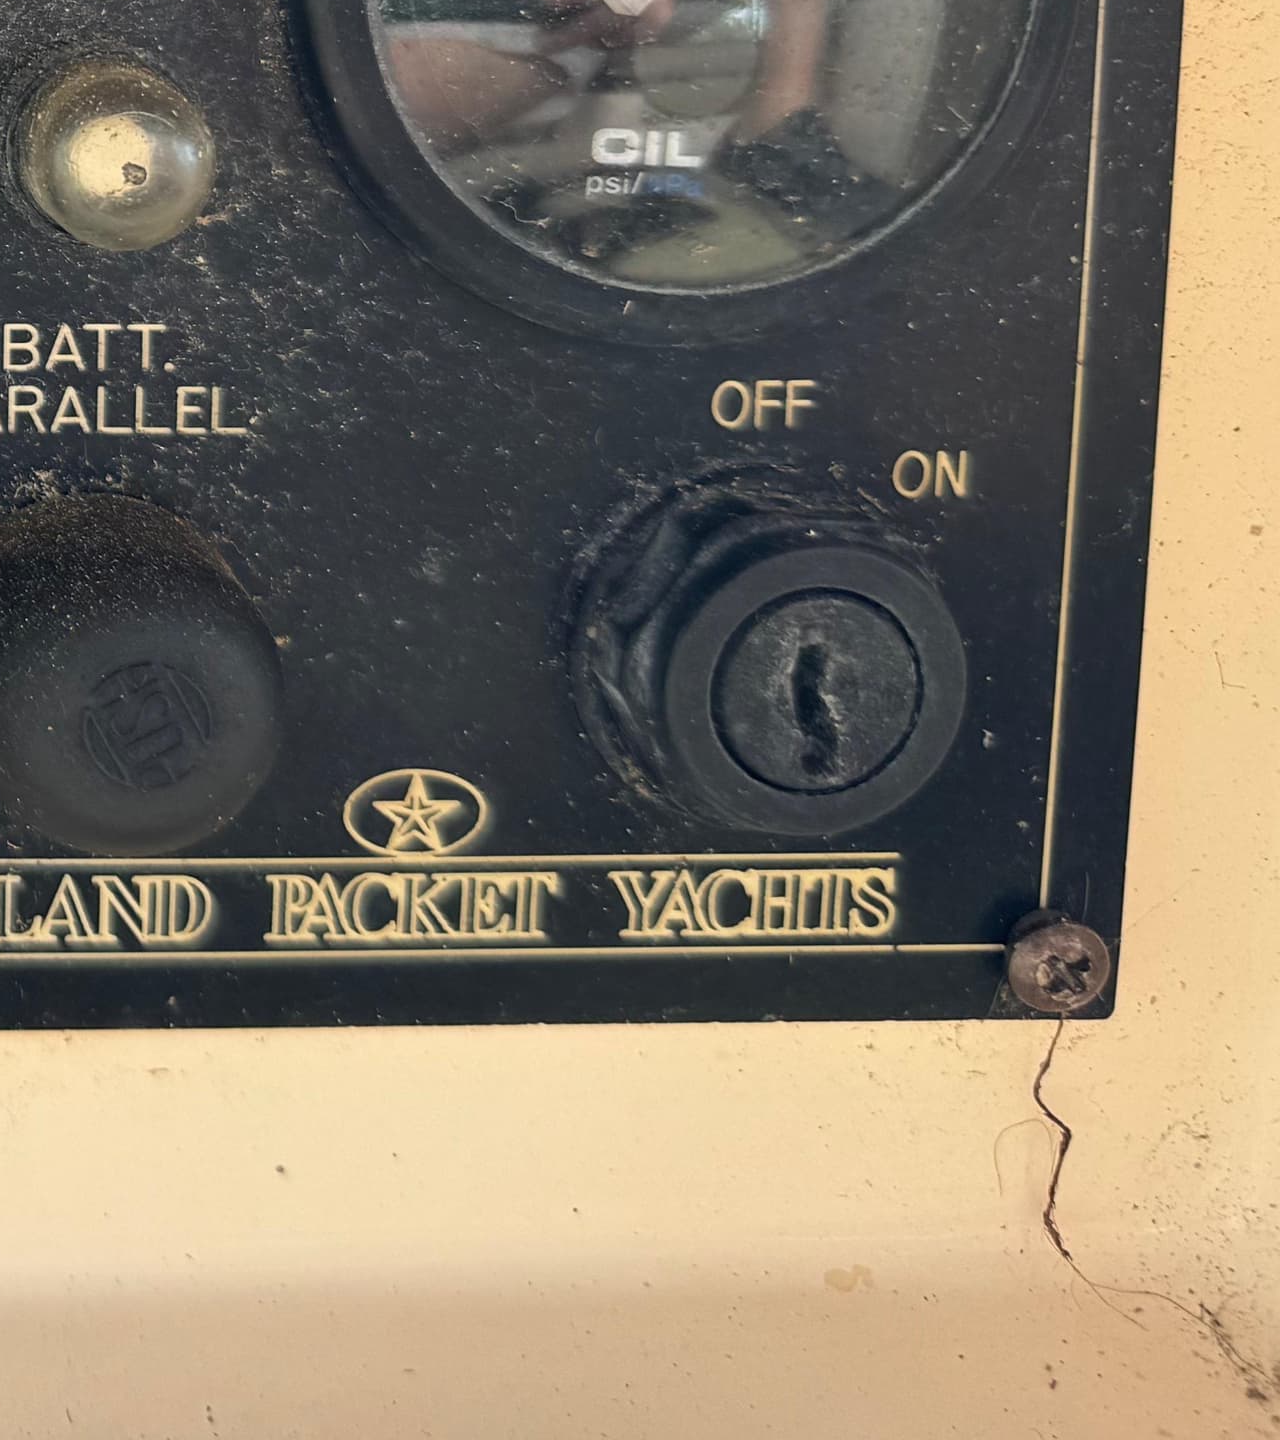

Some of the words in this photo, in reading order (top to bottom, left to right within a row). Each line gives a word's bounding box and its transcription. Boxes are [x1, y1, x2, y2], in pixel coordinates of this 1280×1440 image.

[591, 127, 705, 168] OIL
[2, 322, 176, 373] BATT.
[710, 378, 817, 430] OFF
[891, 449, 969, 499] ON
[262, 871, 562, 944] PACKET
[607, 866, 898, 940] YACHTS
